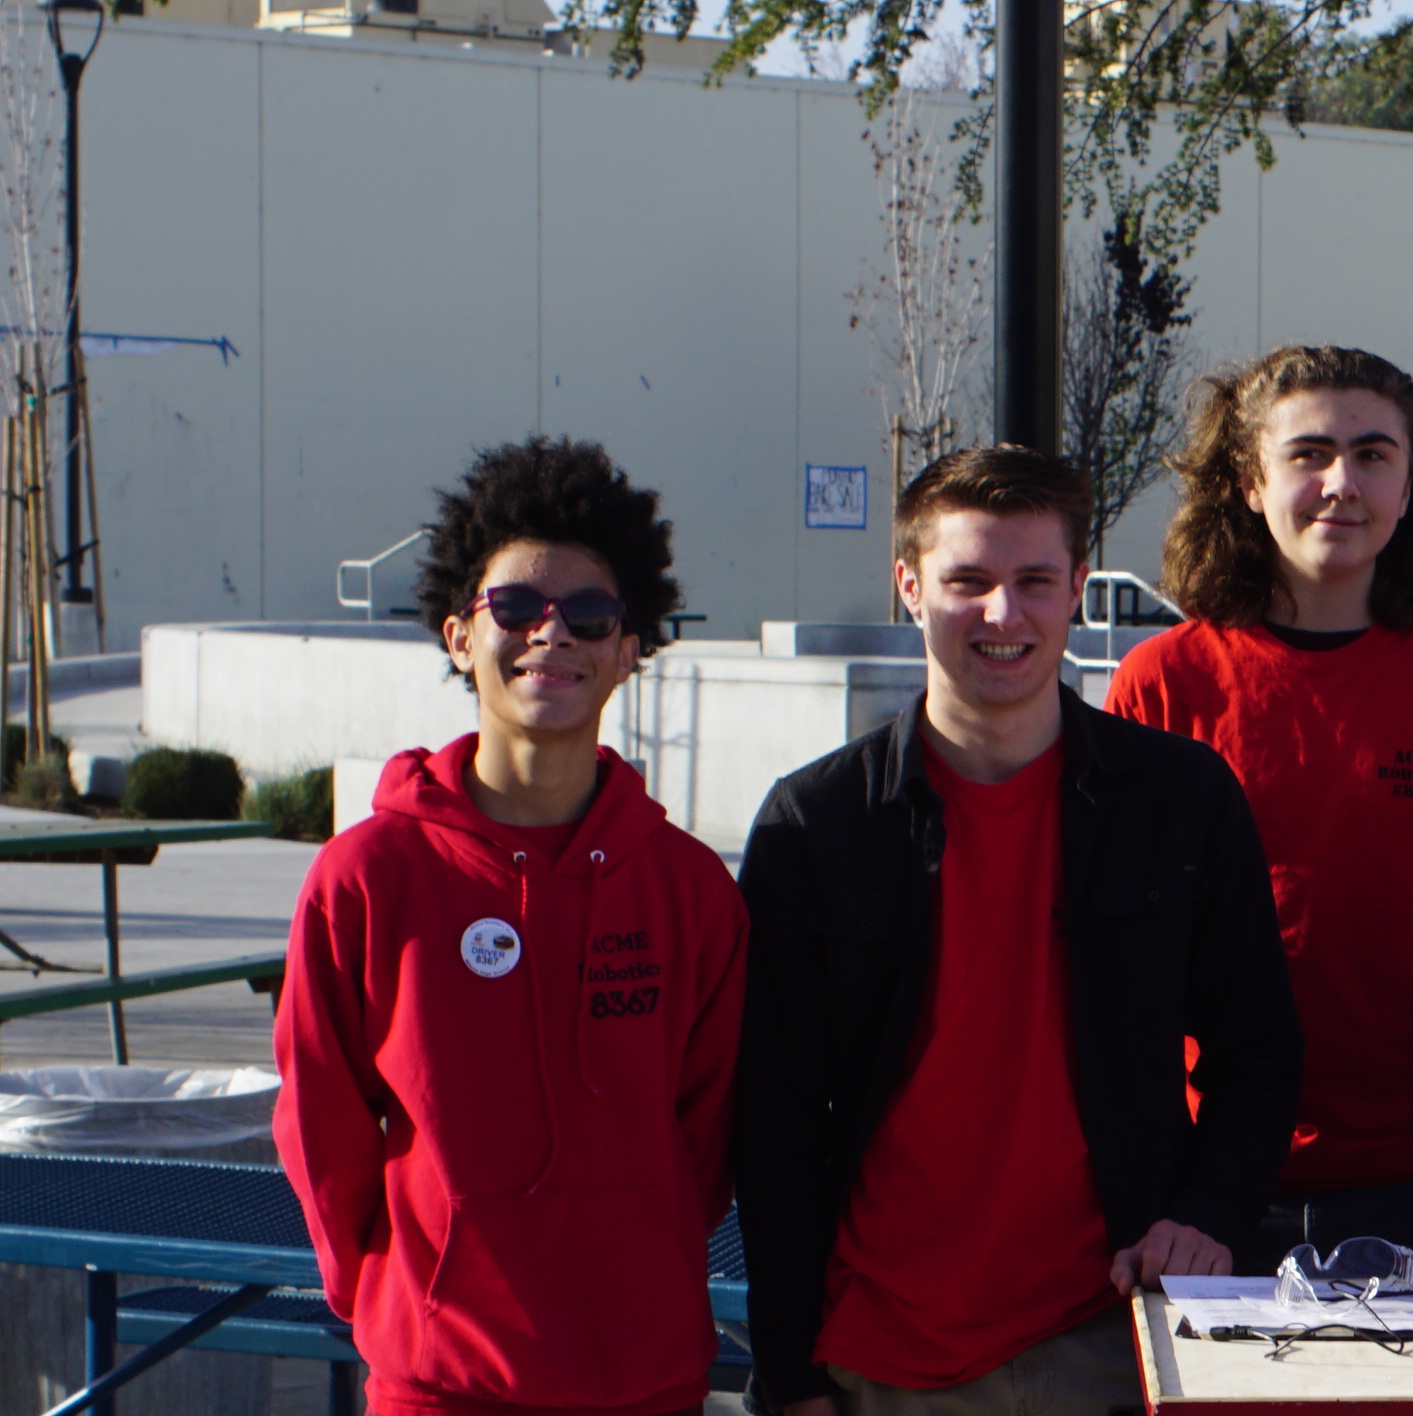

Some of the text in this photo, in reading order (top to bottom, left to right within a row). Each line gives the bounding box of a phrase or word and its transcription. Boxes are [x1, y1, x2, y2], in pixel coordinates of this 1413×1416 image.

[592, 931, 649, 953] ACME
[471, 946, 505, 959] DRIVER
[476, 954, 499, 966] 8367
[590, 987, 659, 1019] 8367
